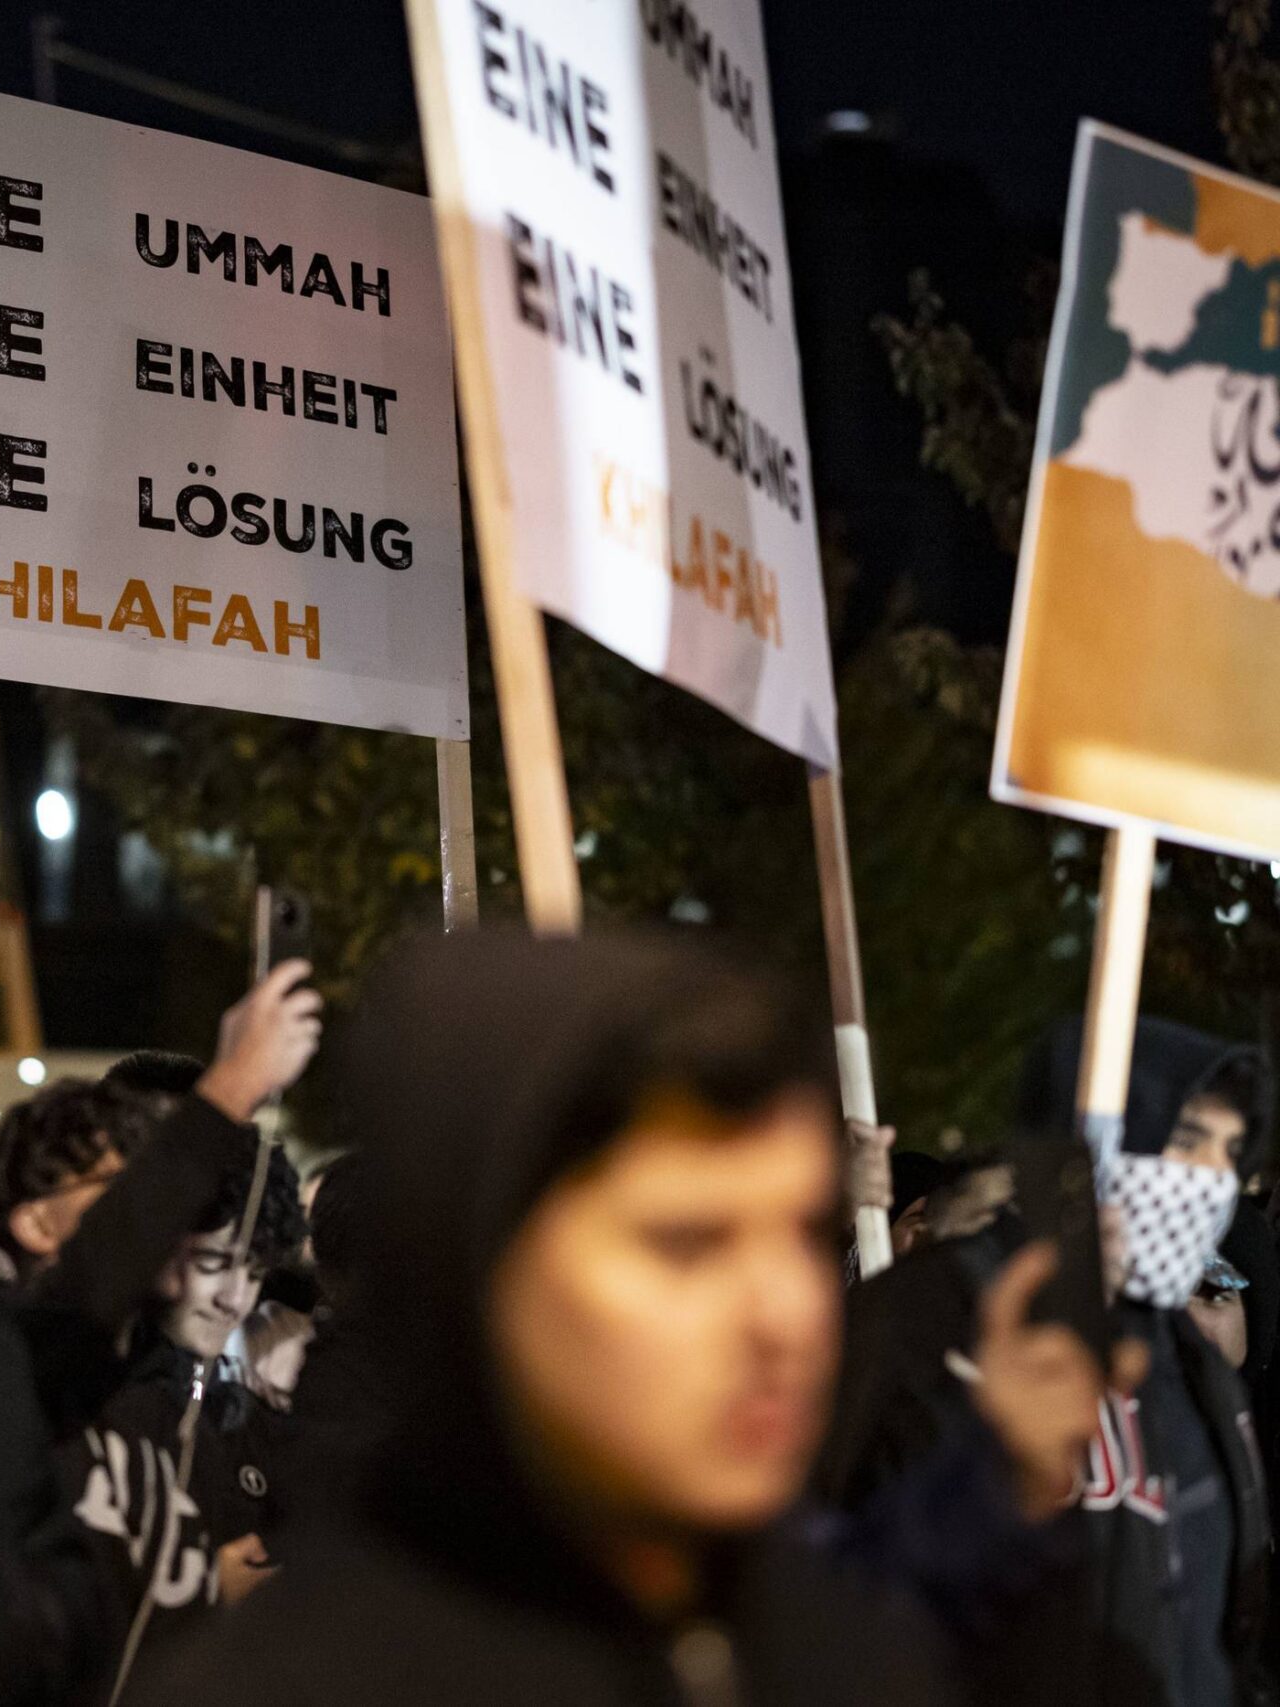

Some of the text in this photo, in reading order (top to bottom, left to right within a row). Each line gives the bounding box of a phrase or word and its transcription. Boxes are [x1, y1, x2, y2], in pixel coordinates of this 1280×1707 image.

[472, 0, 773, 325] EINE EINHEIT
[135, 212, 392, 317] UMMAH
[136, 338, 397, 435] EINHEIT
[506, 211, 802, 523] EINE LÖSUNG
[138, 462, 414, 571] LÖSUNG
